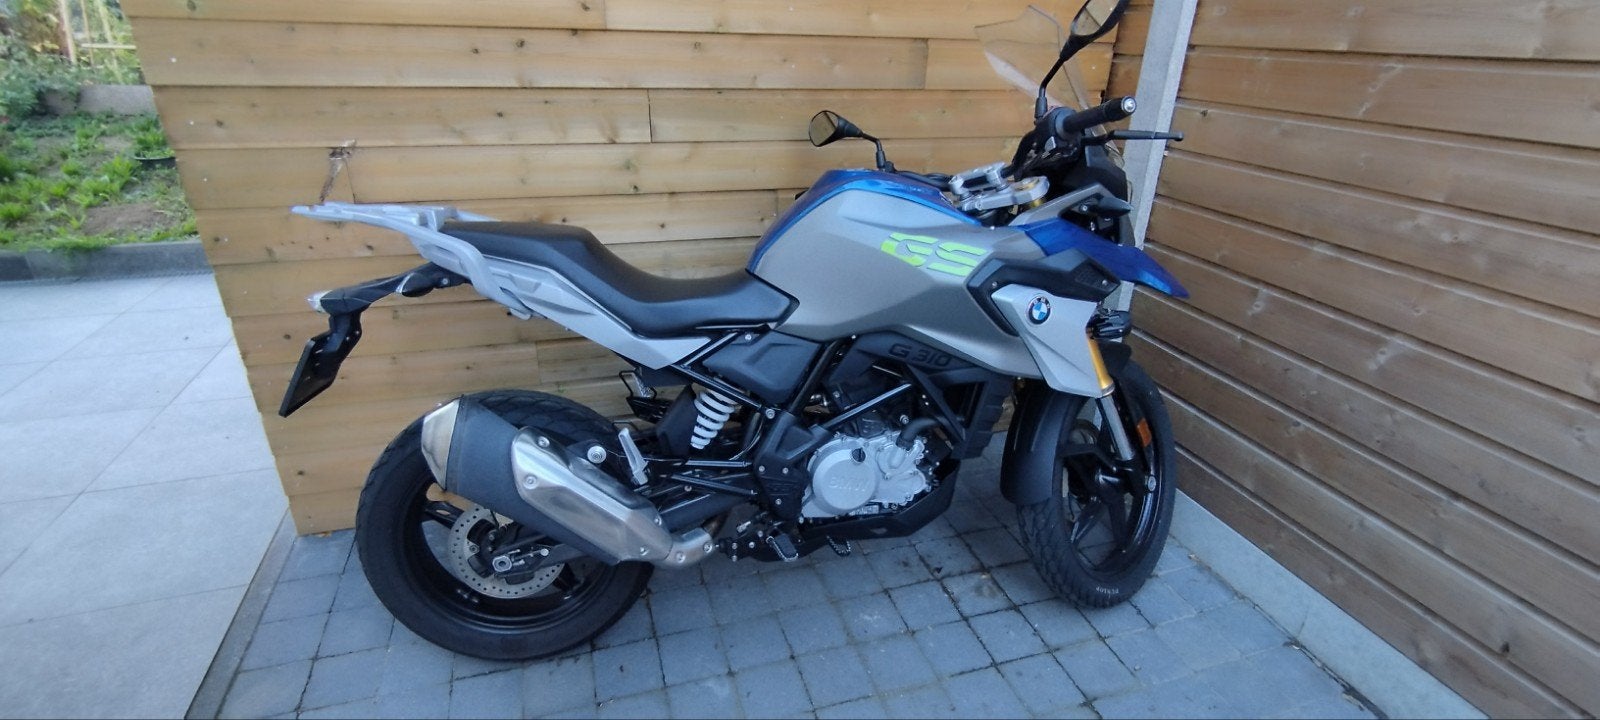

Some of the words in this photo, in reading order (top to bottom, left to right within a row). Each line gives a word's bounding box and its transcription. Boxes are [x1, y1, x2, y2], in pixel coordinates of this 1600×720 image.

[881, 232, 988, 277] GS
[889, 343, 912, 358] G
[911, 349, 952, 367] 310
